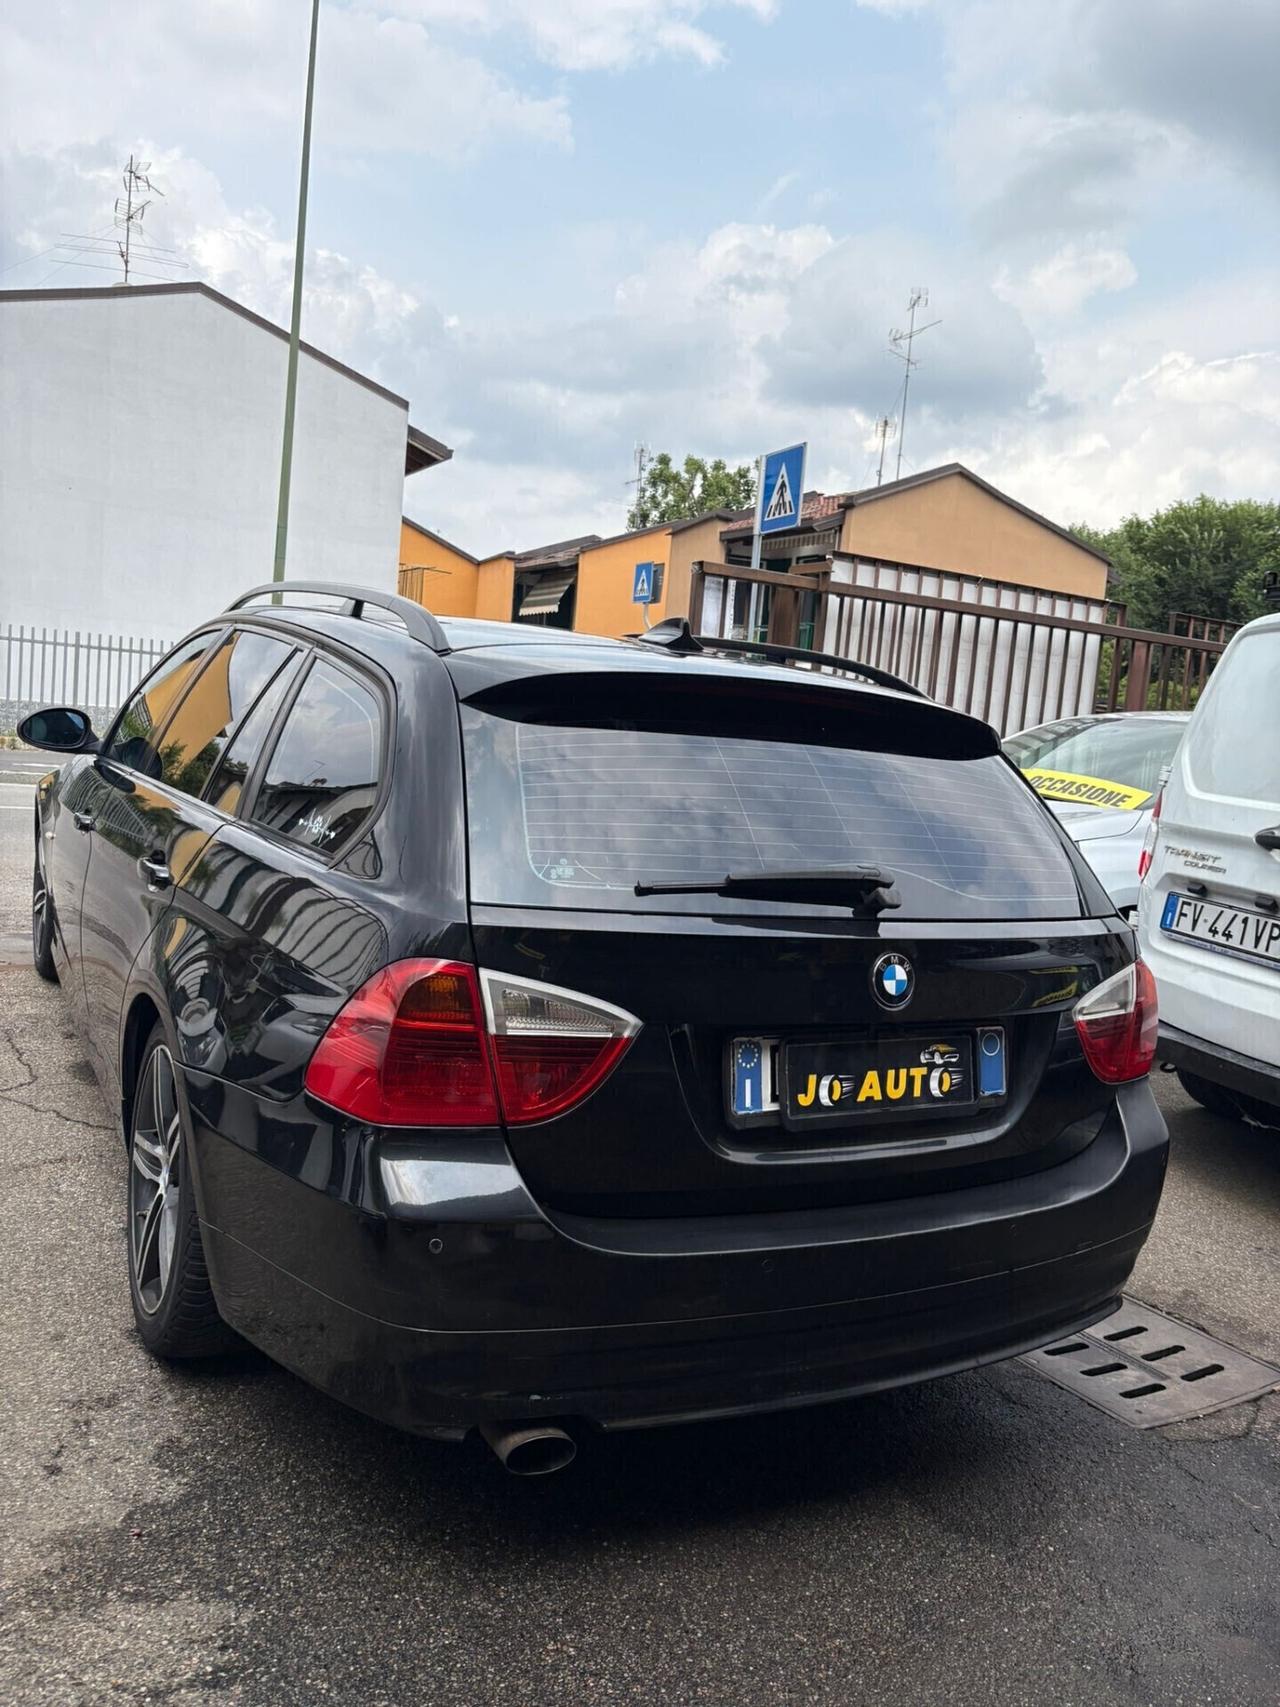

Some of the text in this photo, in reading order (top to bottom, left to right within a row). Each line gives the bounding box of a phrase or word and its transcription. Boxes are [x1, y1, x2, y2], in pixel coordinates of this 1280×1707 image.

[1030, 775, 1132, 807] OCCASIONE
[879, 955, 912, 972] BMW
[797, 1066, 951, 1107] JO AUTO
